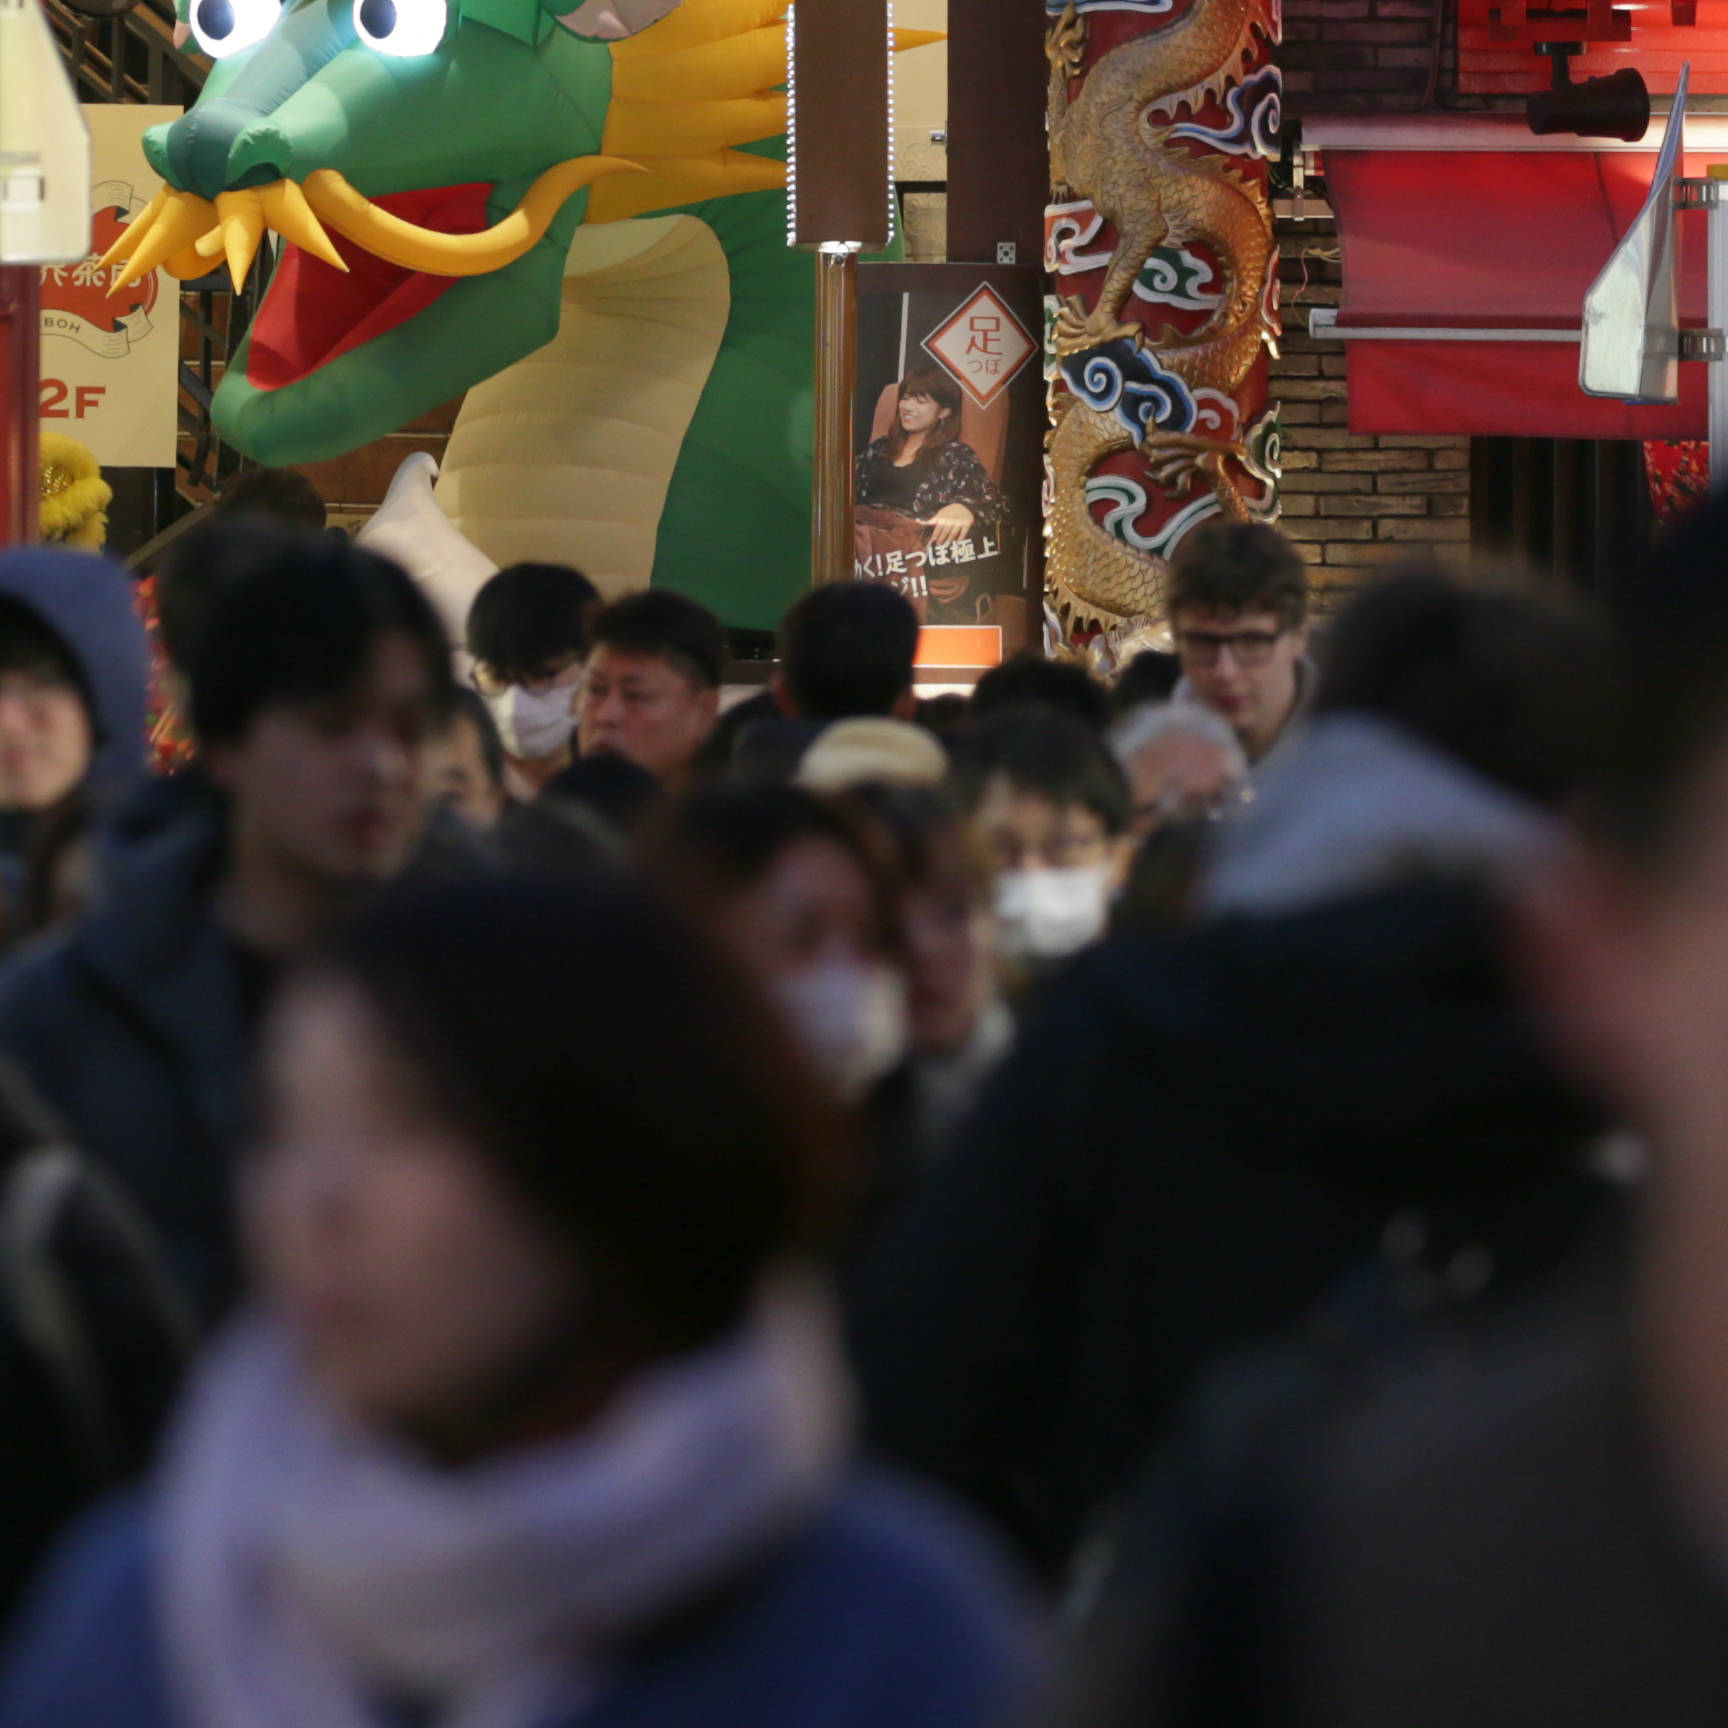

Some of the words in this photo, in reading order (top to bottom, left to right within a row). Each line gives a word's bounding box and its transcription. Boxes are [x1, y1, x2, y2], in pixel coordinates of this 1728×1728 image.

[40, 316, 82, 334] BOH
[965, 316, 1003, 356] 足
[967, 359, 1002, 375] つぼ
[40, 378, 107, 420] 2F
